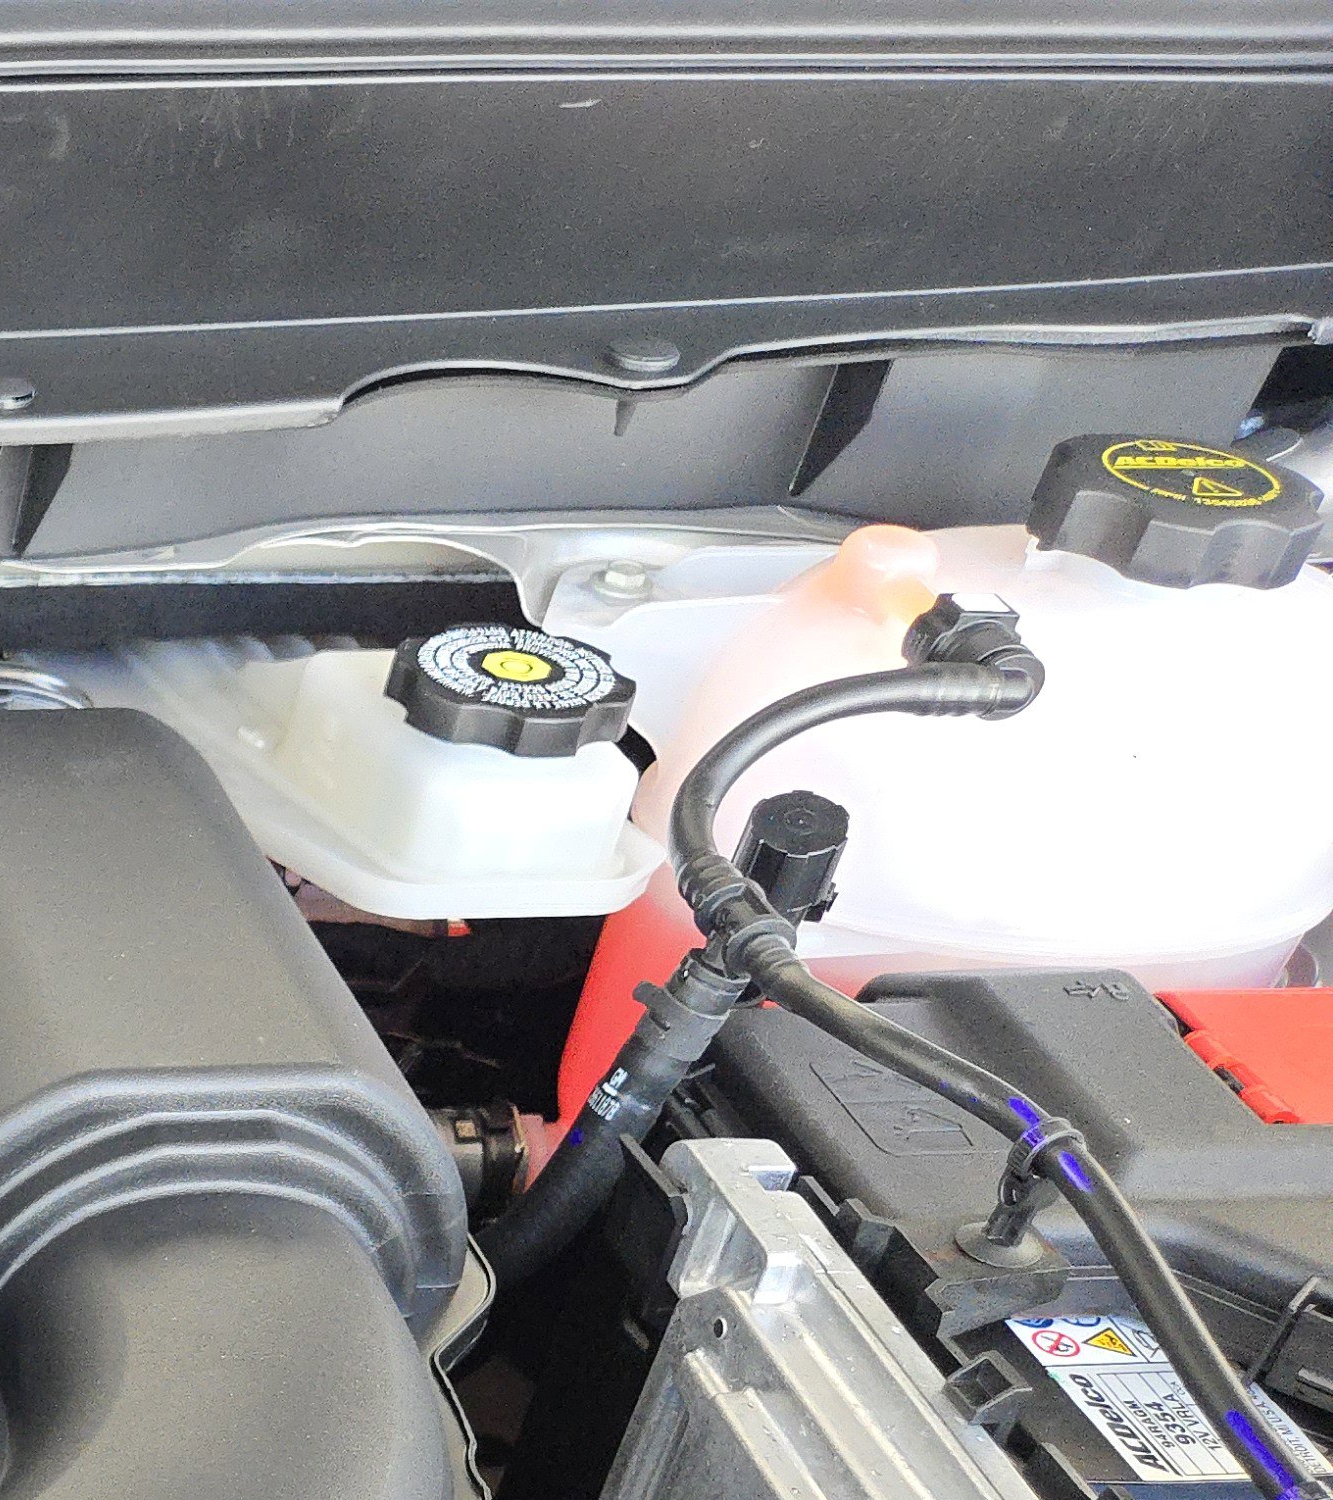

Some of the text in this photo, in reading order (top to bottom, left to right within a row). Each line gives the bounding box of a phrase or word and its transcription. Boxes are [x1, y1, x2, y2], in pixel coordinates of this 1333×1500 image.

[1115, 456, 1247, 468] ACDelco
[1069, 1373, 1169, 1473] ACDelco
[1124, 1401, 1176, 1449] 94RAGM
[1144, 1402, 1197, 1445] 9354
[1163, 1393, 1223, 1451] 12V VRLA
